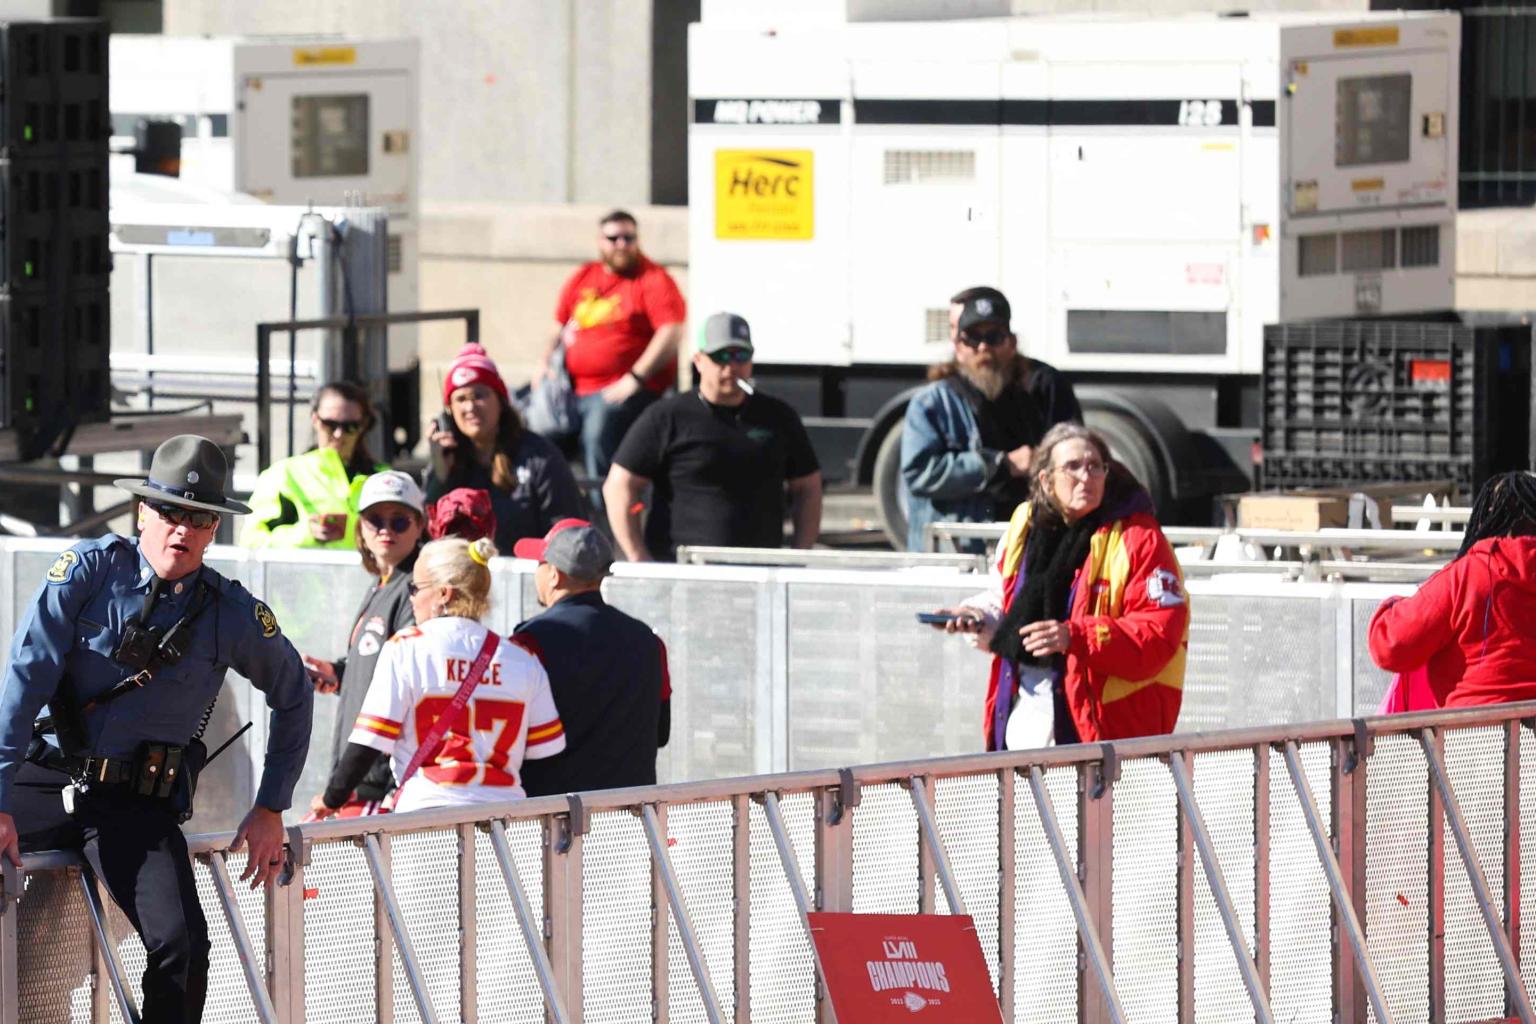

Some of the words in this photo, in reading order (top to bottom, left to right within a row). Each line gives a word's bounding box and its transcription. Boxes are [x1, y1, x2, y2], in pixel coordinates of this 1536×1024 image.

[750, 100, 822, 124] POWER
[728, 168, 801, 197] Herc
[415, 695, 526, 787] 87
[865, 960, 951, 994] CHAMPIONS
